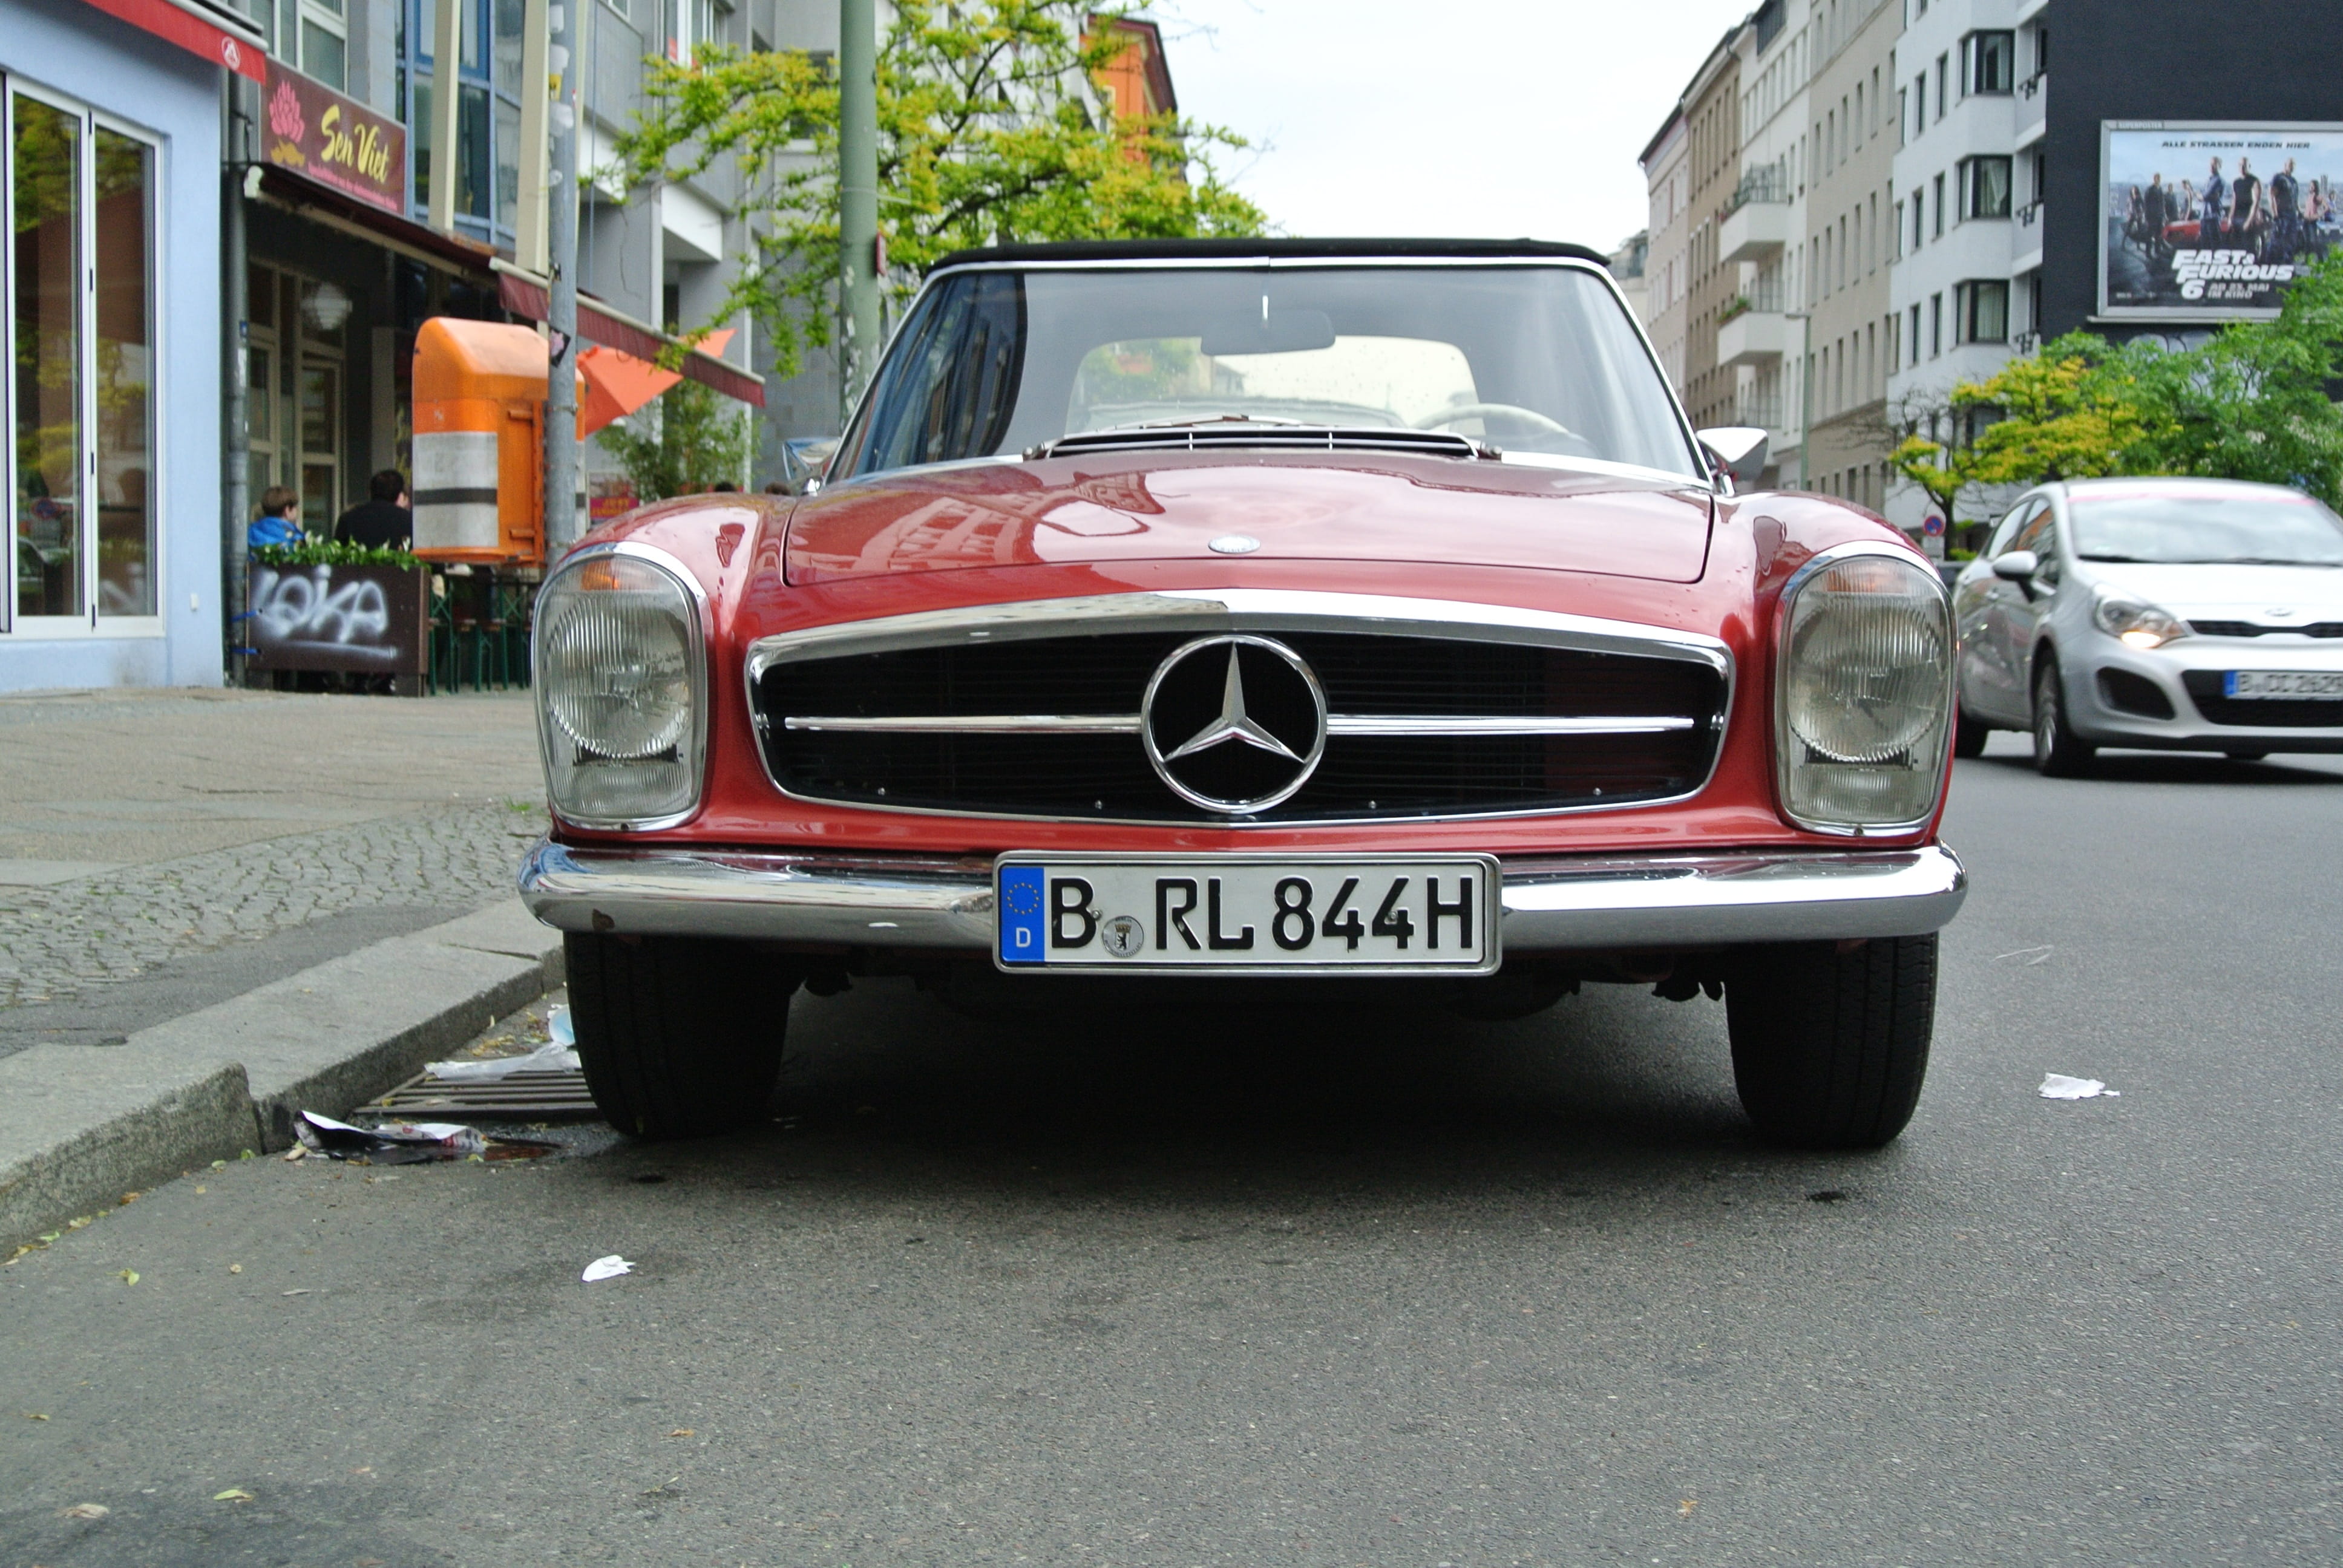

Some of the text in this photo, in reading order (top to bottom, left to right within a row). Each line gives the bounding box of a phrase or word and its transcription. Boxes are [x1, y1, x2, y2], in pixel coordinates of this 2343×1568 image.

[321, 103, 389, 183] Sen Viet
[2176, 264, 2295, 284] FURIOUS
[2181, 279, 2206, 299] 6
[2224, 290, 2253, 299] KINO
[2246, 283, 2270, 292] MAI
[1050, 877, 1096, 949] B
[1016, 927, 1031, 948] D
